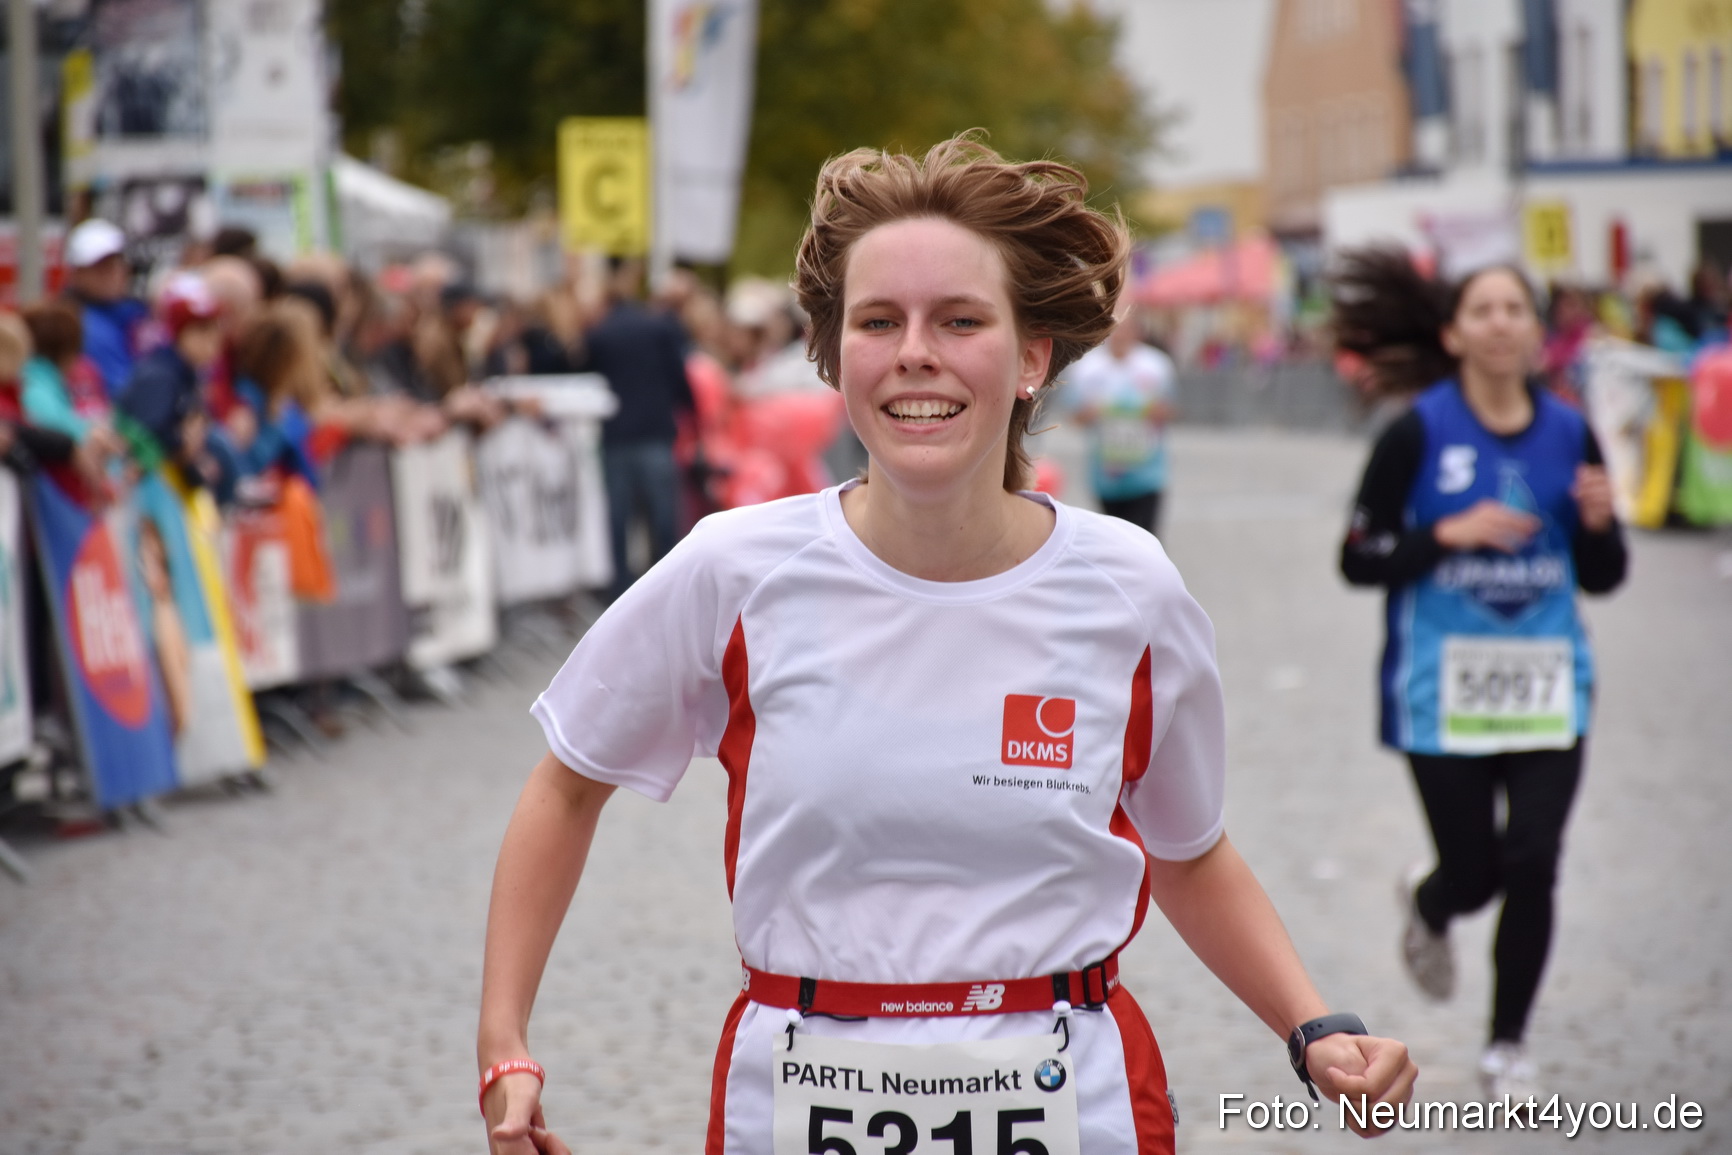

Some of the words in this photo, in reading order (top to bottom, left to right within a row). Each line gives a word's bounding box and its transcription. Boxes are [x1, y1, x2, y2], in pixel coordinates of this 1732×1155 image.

[582, 161, 632, 222] C
[1437, 445, 1477, 494] 5
[1458, 670, 1558, 710] 5097
[1007, 740, 1068, 762] DKMS
[972, 775, 990, 785] Wir
[993, 776, 1043, 790] besiegen
[1046, 780, 1091, 794] Blutkrebs.
[881, 1002, 904, 1013] new
[906, 1000, 954, 1013] balance
[961, 984, 1006, 1012] NB
[782, 1061, 874, 1093] PARTL
[881, 1069, 1022, 1095] Neumarkt
[808, 1105, 1050, 1155] 5315
